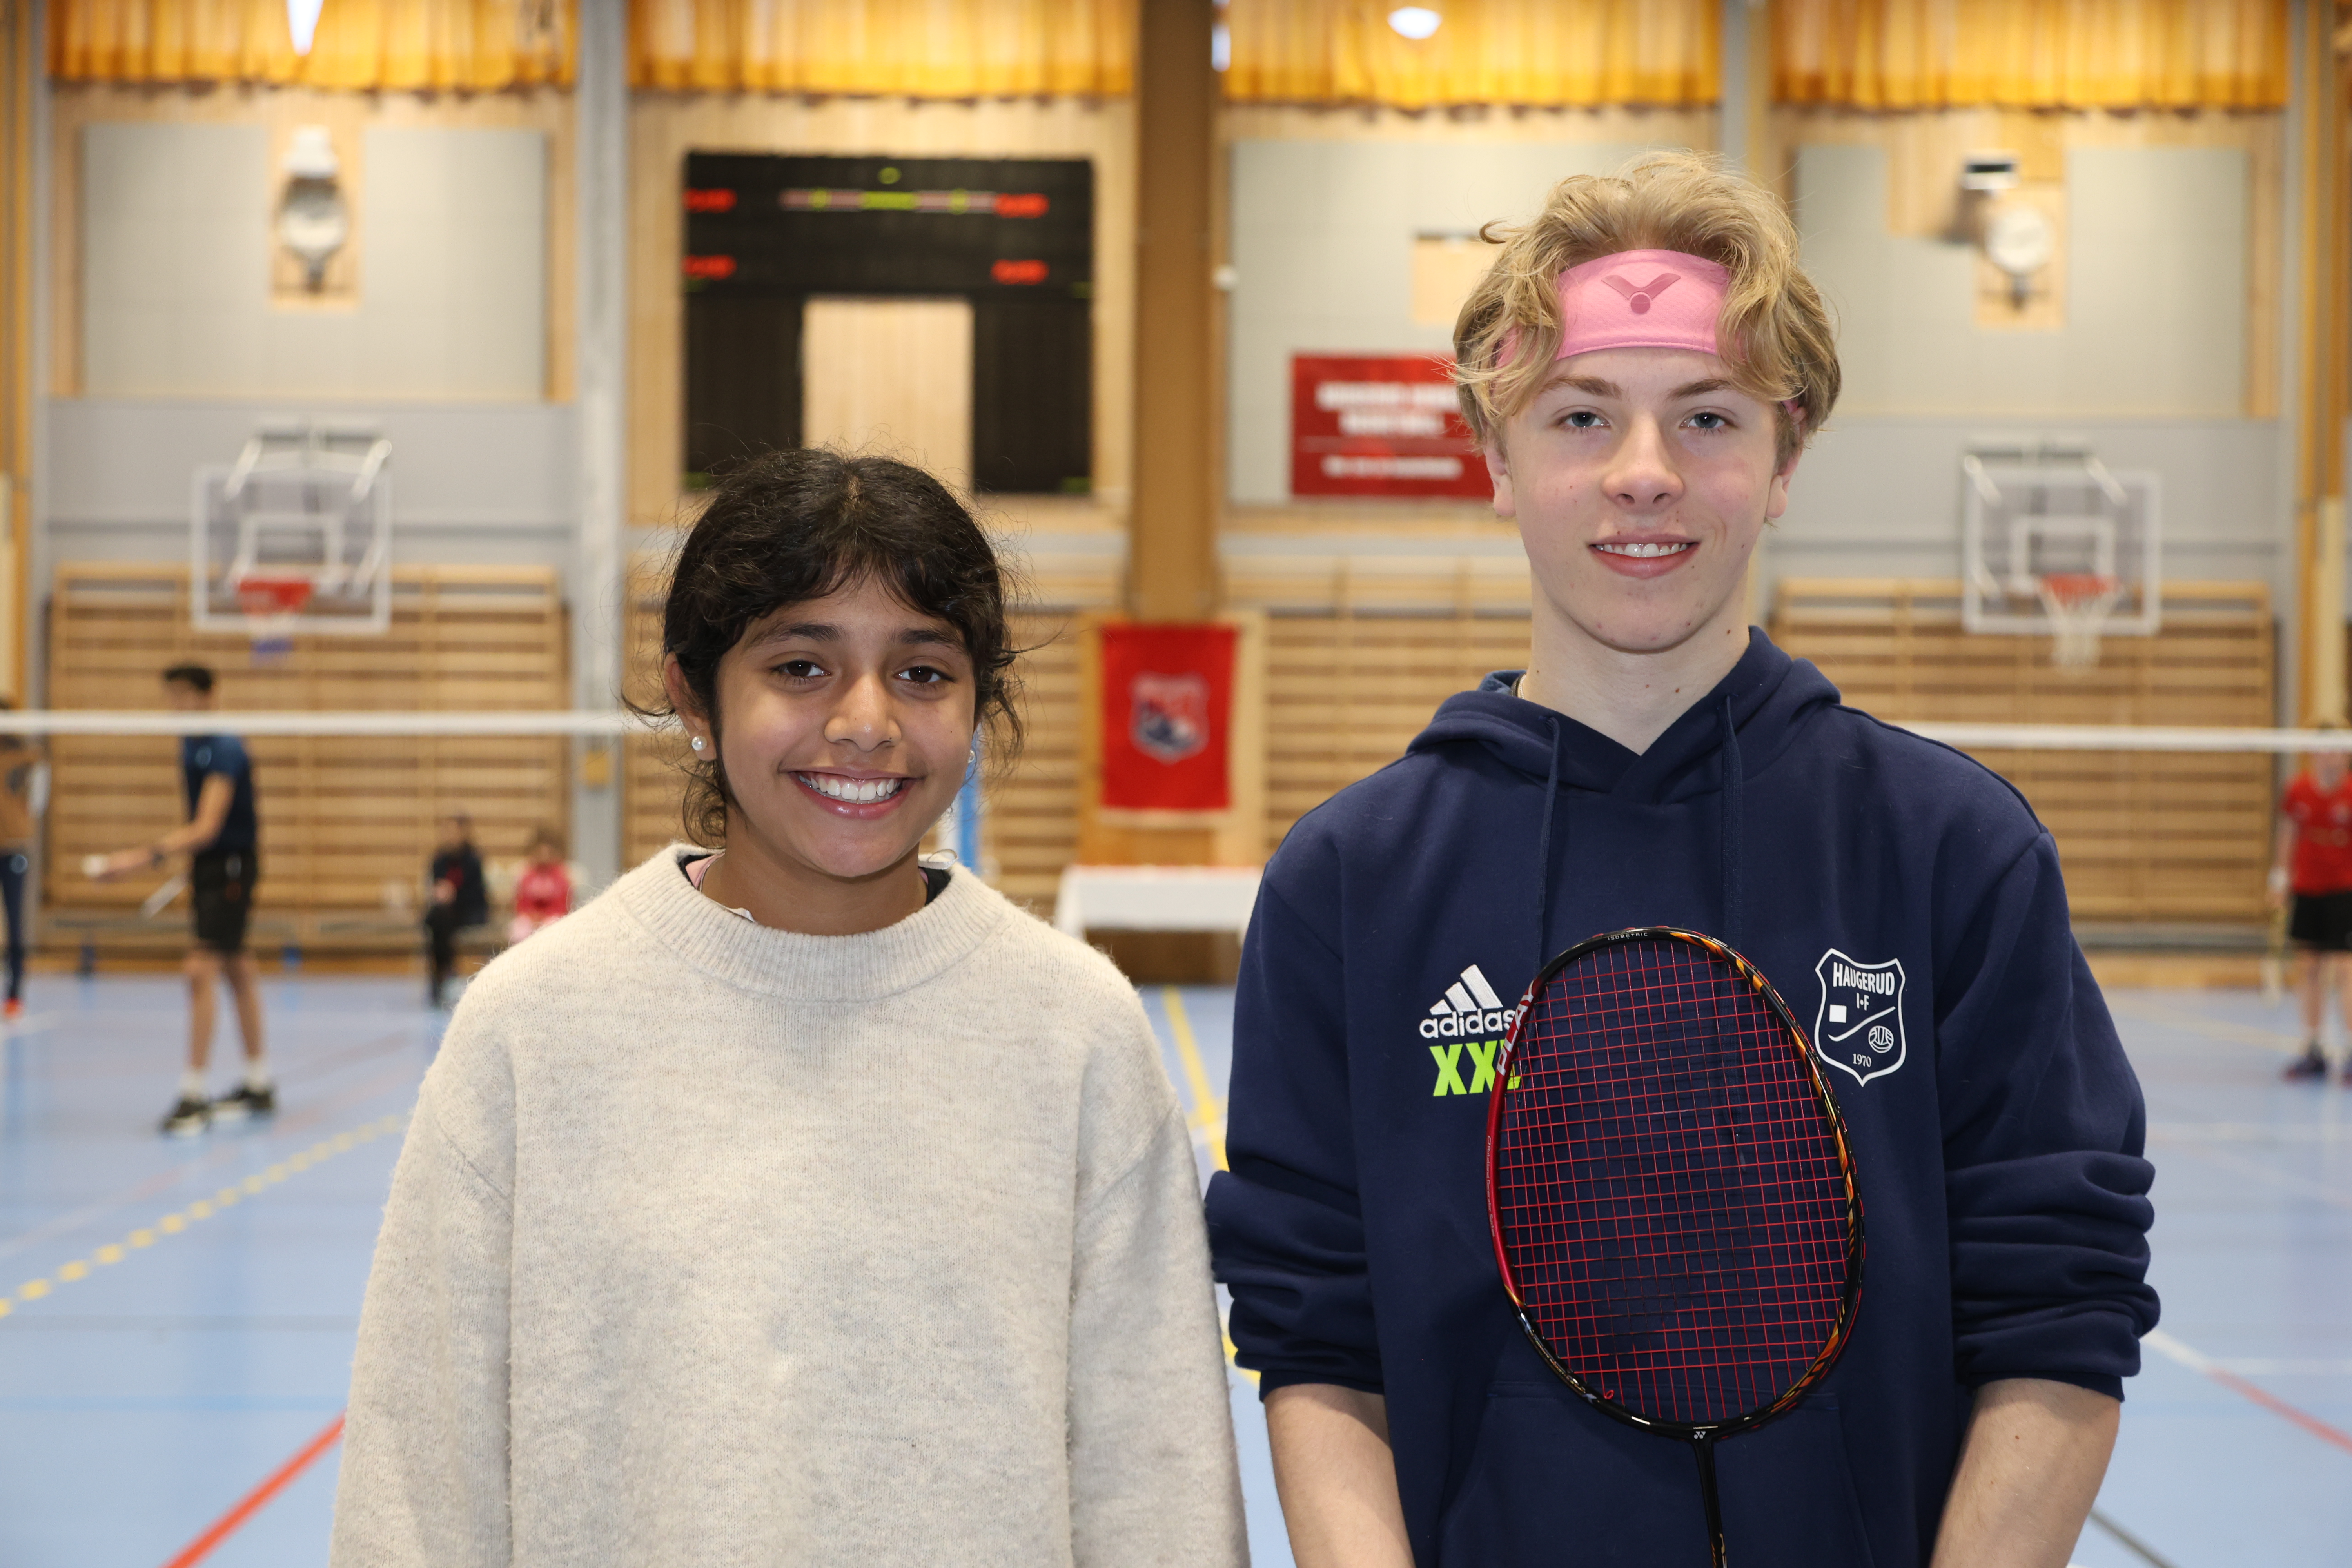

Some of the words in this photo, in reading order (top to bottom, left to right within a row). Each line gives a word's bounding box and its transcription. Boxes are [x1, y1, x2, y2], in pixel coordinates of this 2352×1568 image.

[1608, 932, 1648, 941] ISOMETRIC
[1833, 962, 1895, 996] HAUGERUD
[1419, 1008, 1516, 1038] adidas
[1497, 980, 1534, 1076] PLAY
[1852, 1053, 1872, 1067] 1970
